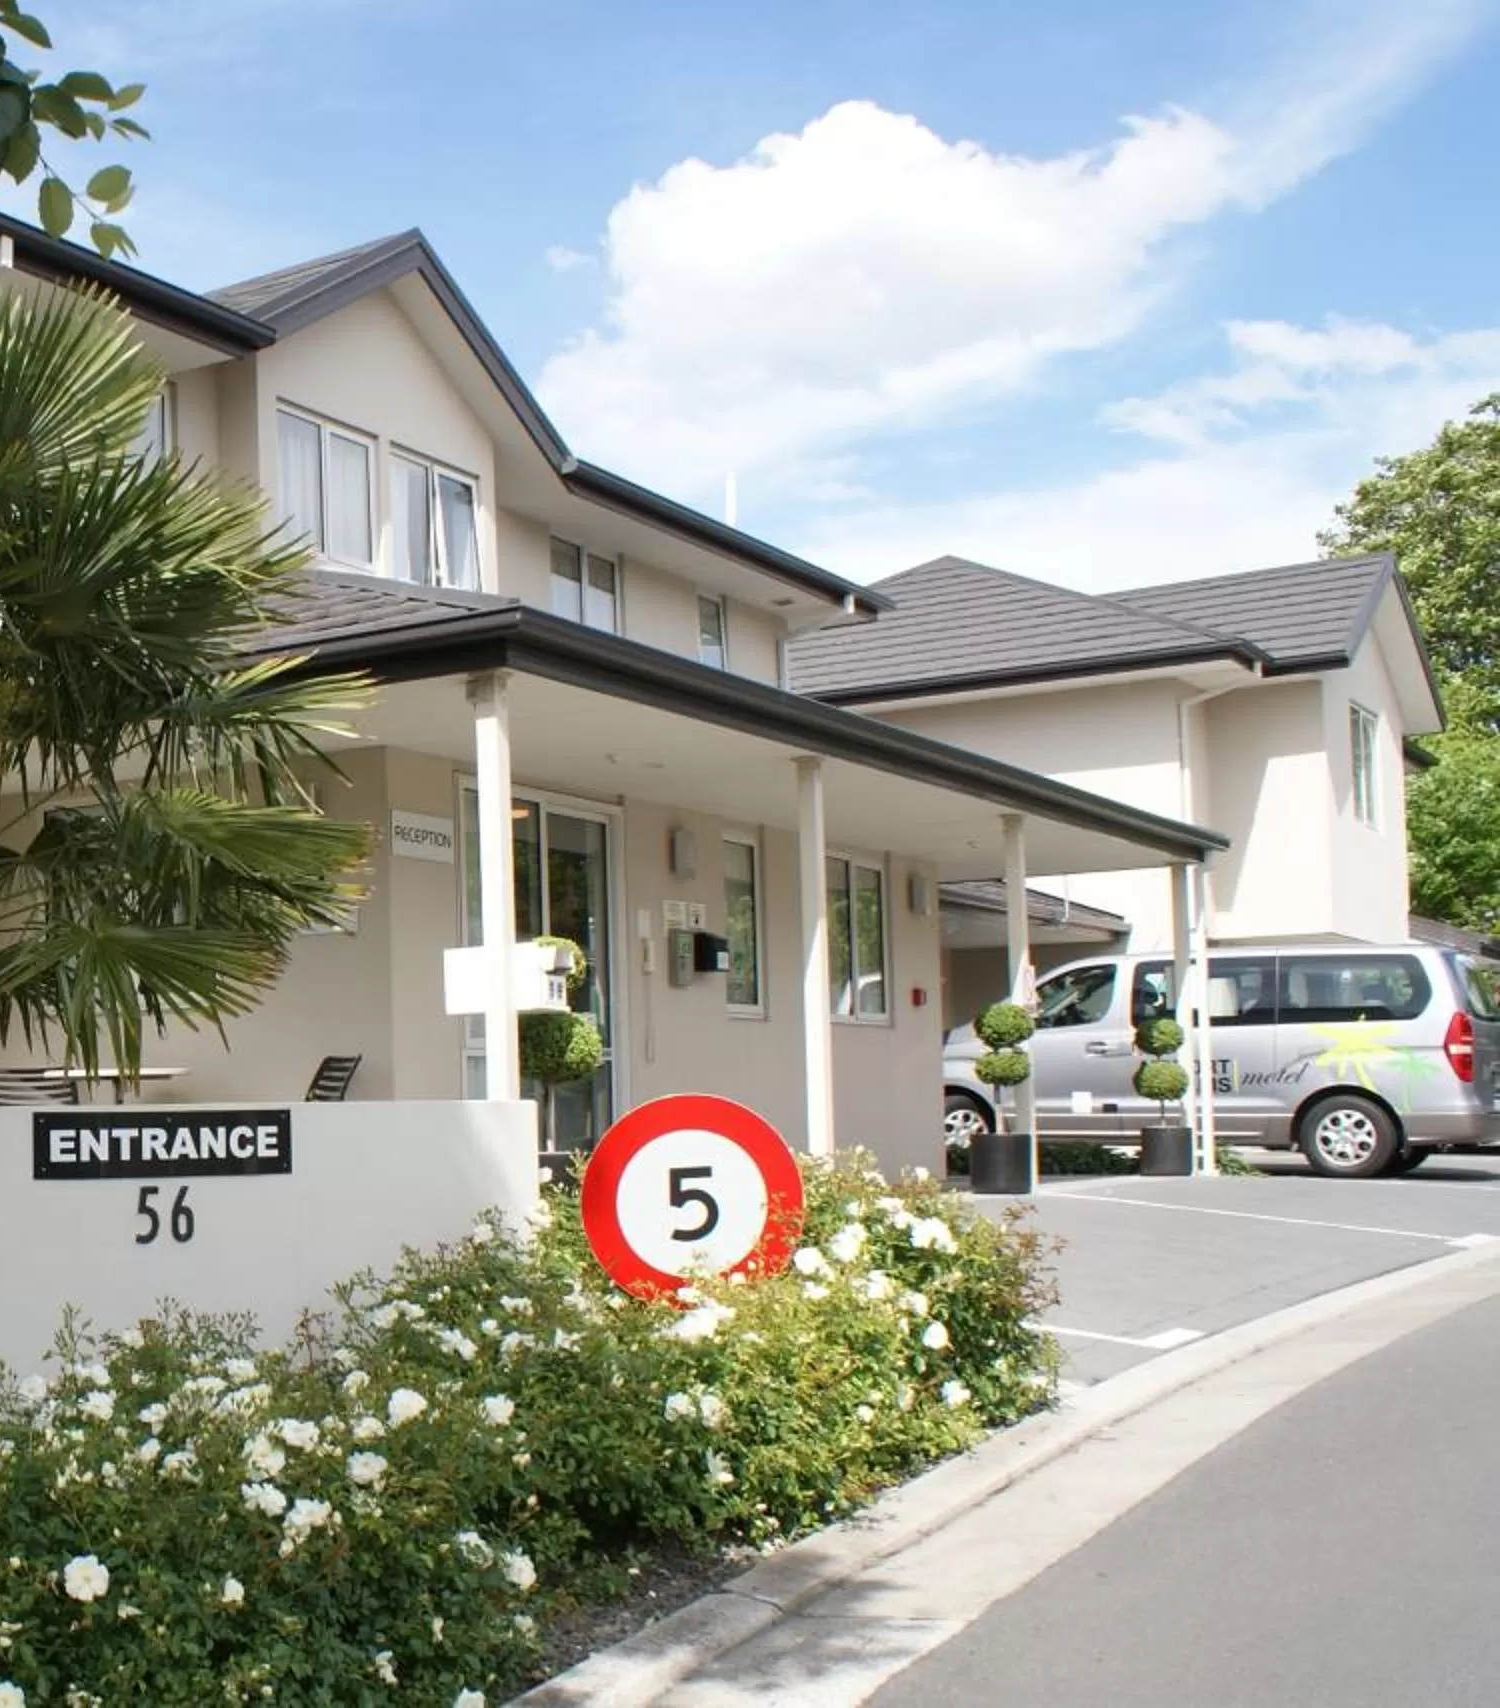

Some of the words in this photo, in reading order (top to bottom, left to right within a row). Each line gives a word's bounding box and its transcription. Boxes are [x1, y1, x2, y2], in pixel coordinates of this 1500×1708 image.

[394, 824, 451, 849] RECEPTION
[1241, 1062, 1309, 1087] motel
[48, 1124, 279, 1163] ENTRANCE
[134, 1184, 196, 1245] 56
[668, 1165, 719, 1242] 5
